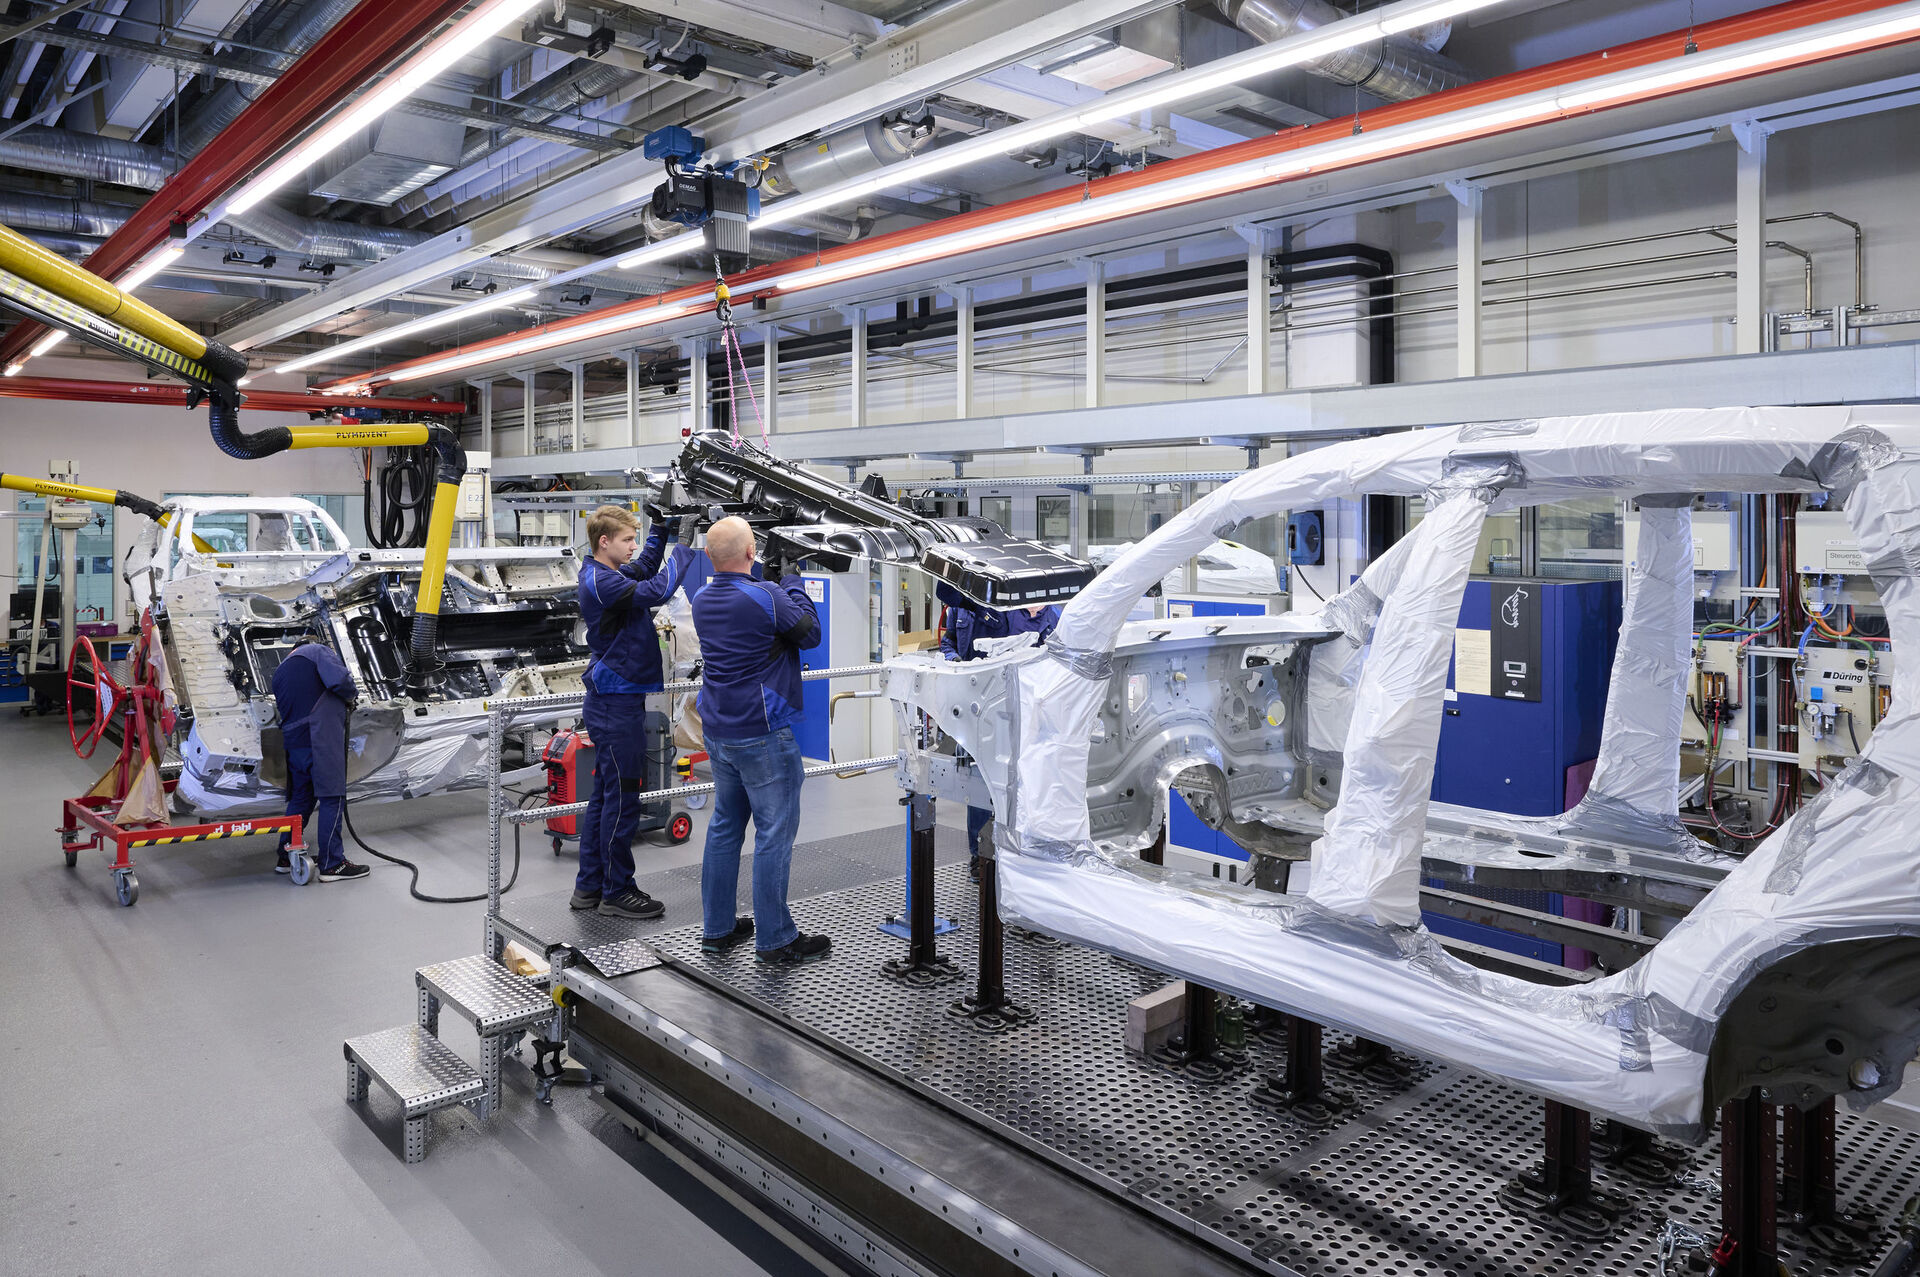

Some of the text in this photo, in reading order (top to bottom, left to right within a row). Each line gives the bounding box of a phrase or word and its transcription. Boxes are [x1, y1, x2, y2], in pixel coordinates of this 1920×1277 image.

[336, 431, 387, 439] PLYMOVENT
[35, 484, 79, 493] PLYMOVENT
[1832, 671, 1863, 684] Düring
